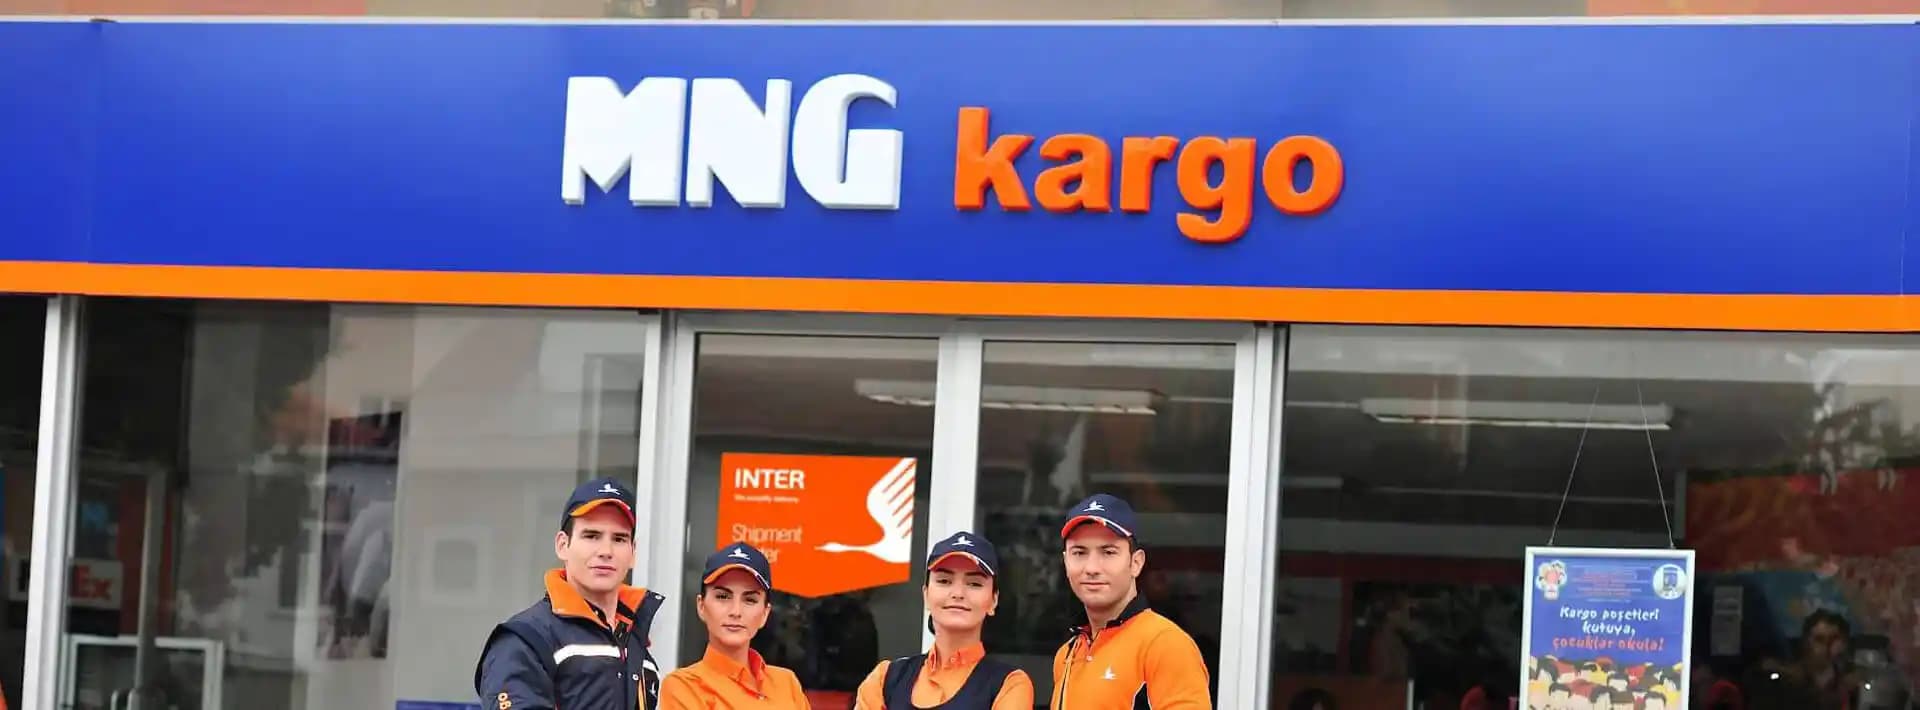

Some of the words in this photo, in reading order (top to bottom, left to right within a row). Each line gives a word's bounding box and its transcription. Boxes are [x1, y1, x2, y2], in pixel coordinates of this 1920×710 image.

[562, 74, 903, 210] MNG
[954, 106, 1345, 244] kargo
[735, 467, 806, 490] INTER
[731, 523, 803, 545] Shipment
[1560, 606, 1598, 620] Kargo
[1602, 607, 1660, 621] poşetleri
[1582, 620, 1636, 636] kutuya,
